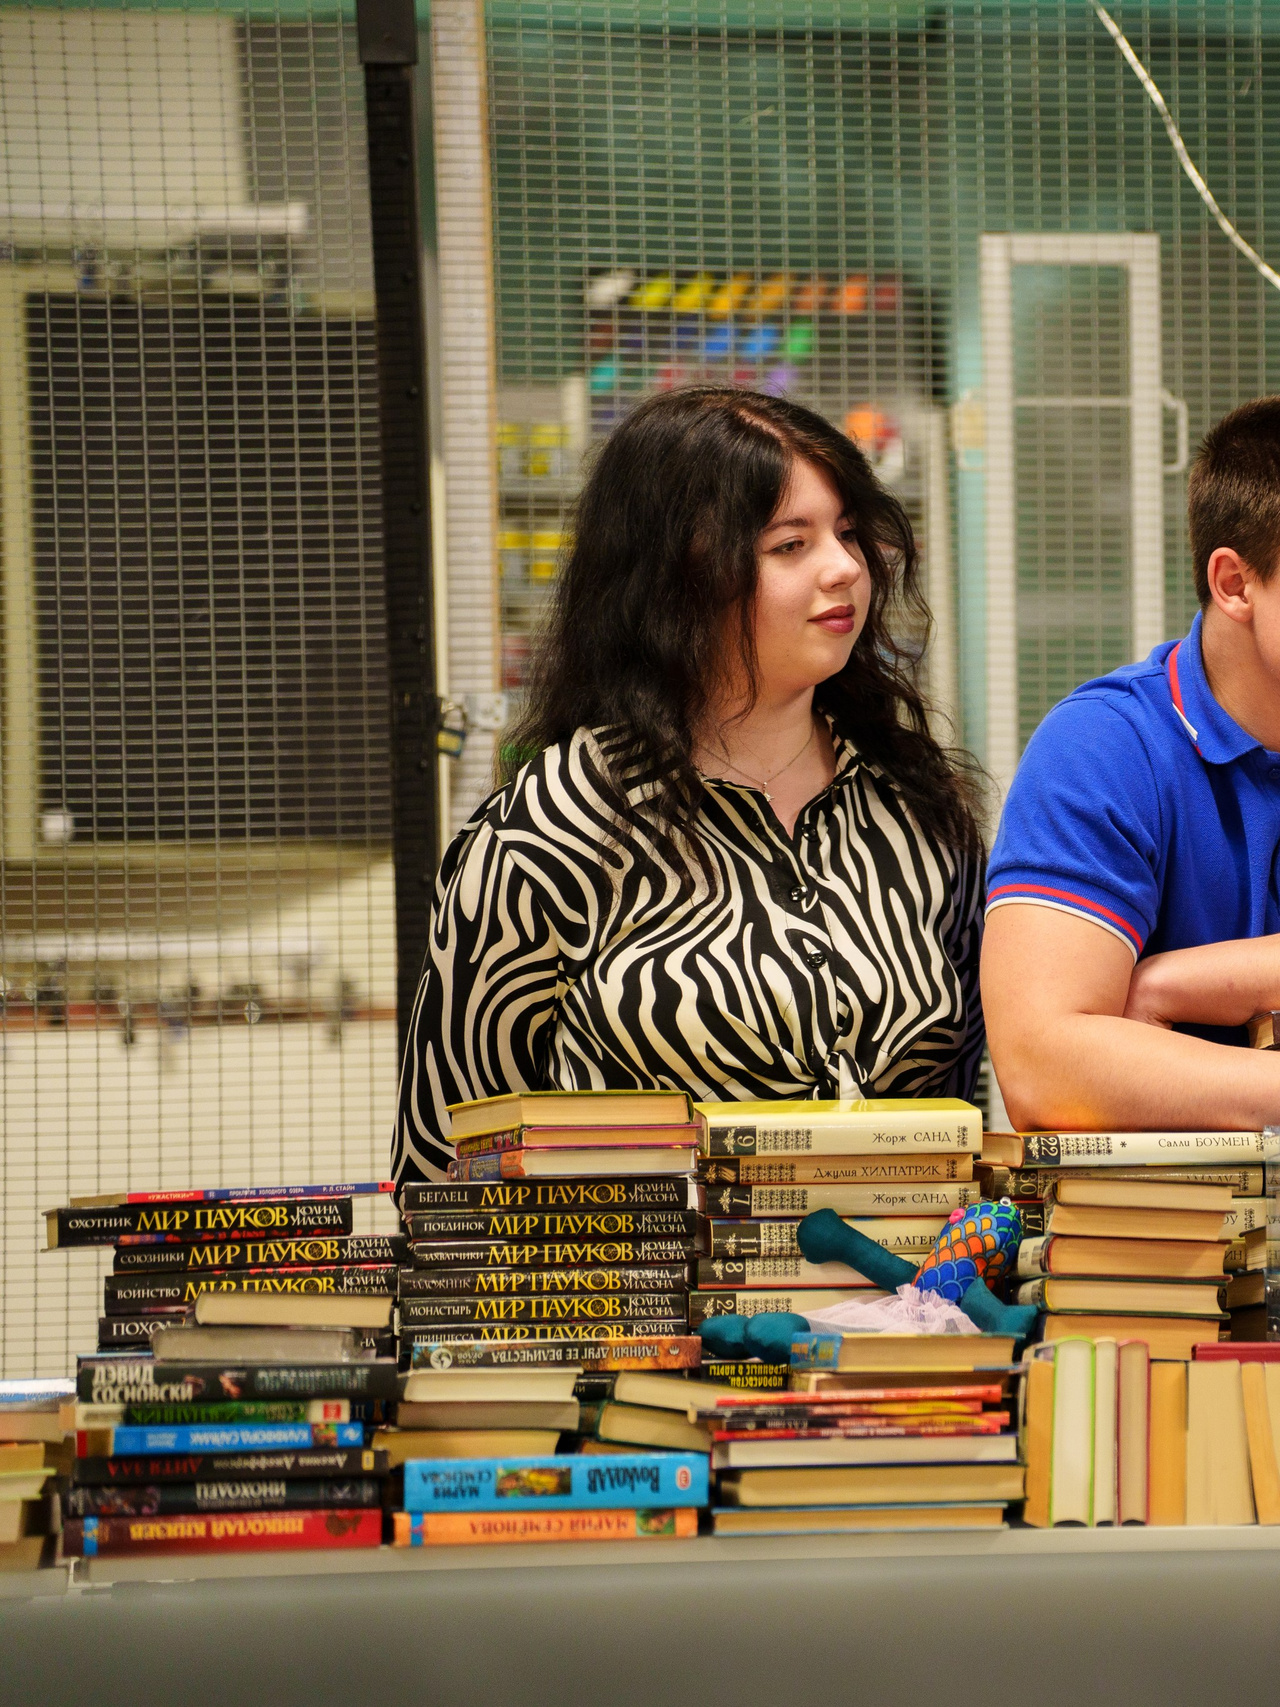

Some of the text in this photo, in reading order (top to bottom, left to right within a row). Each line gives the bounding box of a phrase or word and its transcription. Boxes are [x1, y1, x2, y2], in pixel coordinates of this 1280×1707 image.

[736, 1135, 755, 1148] 9
[872, 1130, 952, 1145] Жорж САНД
[1158, 1136, 1250, 1148] Салли БОУМЕН
[1041, 1136, 1058, 1157] 22
[813, 1164, 941, 1179] Джулия ХИЛПАТРИК
[335, 1184, 356, 1192] СТАЙН
[634, 1183, 676, 1195] КОЛИНА
[1019, 1172, 1037, 1196] 30
[419, 1191, 469, 1204] БЕГЛЕЦ
[480, 1183, 627, 1206] МИР ПАУКОВ
[628, 1191, 680, 1204] УИЛСОНА
[732, 1190, 750, 1205] 7
[872, 1192, 949, 1206] Жорж САНД
[295, 1204, 340, 1217] КОЛИНА
[68, 1217, 132, 1229] ОХОТНИК
[136, 1206, 289, 1232] МИР ПАУКОВ
[290, 1213, 343, 1227] УИЛСОНА
[487, 1213, 635, 1236] МИР ПАУКОВ
[641, 1213, 684, 1225] КОЛИНА
[1025, 1211, 1043, 1234] 17
[424, 1220, 485, 1233] ПОЕДИНОК
[635, 1221, 687, 1234] УИЛСОНА
[347, 1238, 391, 1250] КОЛИНА
[641, 1240, 684, 1252] КОЛИНА
[739, 1236, 758, 1255] 11
[894, 1235, 939, 1246] ЛАГЕР
[120, 1252, 185, 1265] СОЮЗНИКИ
[188, 1240, 340, 1267] МИР ПАУКОВ
[341, 1247, 394, 1260] УИЛСОНА
[423, 1250, 484, 1262] ЗАХВАТЧИКИ
[486, 1242, 635, 1266] МИР ПАУКОВ
[635, 1249, 687, 1262] УИЛСОНА
[725, 1261, 744, 1274] 8
[343, 1275, 387, 1287] КОЛИНА
[409, 1278, 471, 1291] ЗАЛОЖНИК
[474, 1270, 622, 1293] МИР ПАУКОВ
[622, 1278, 674, 1291] УИЛСОНА
[117, 1287, 181, 1300] ВОИНСТВО
[474, 1297, 622, 1320] МИР ПАУКОВ
[628, 1296, 671, 1308] КОЛИНА
[409, 1304, 471, 1317] МОНАСТЫРЬ
[622, 1304, 674, 1317] УИЛСОНА
[632, 1324, 675, 1335] КОЛИНА
[491, 1343, 660, 1364] ТАЙНЫЙ ДРУГ ЕЕ ВЕЛИЧЕСТВА
[92, 1365, 155, 1385] ДЭВИД
[709, 1364, 735, 1376] КАРТЫ
[91, 1384, 194, 1403] СОСНОВСКИ
[130, 1517, 305, 1541] НИКОЛАЙ КНЯЗЕВ
